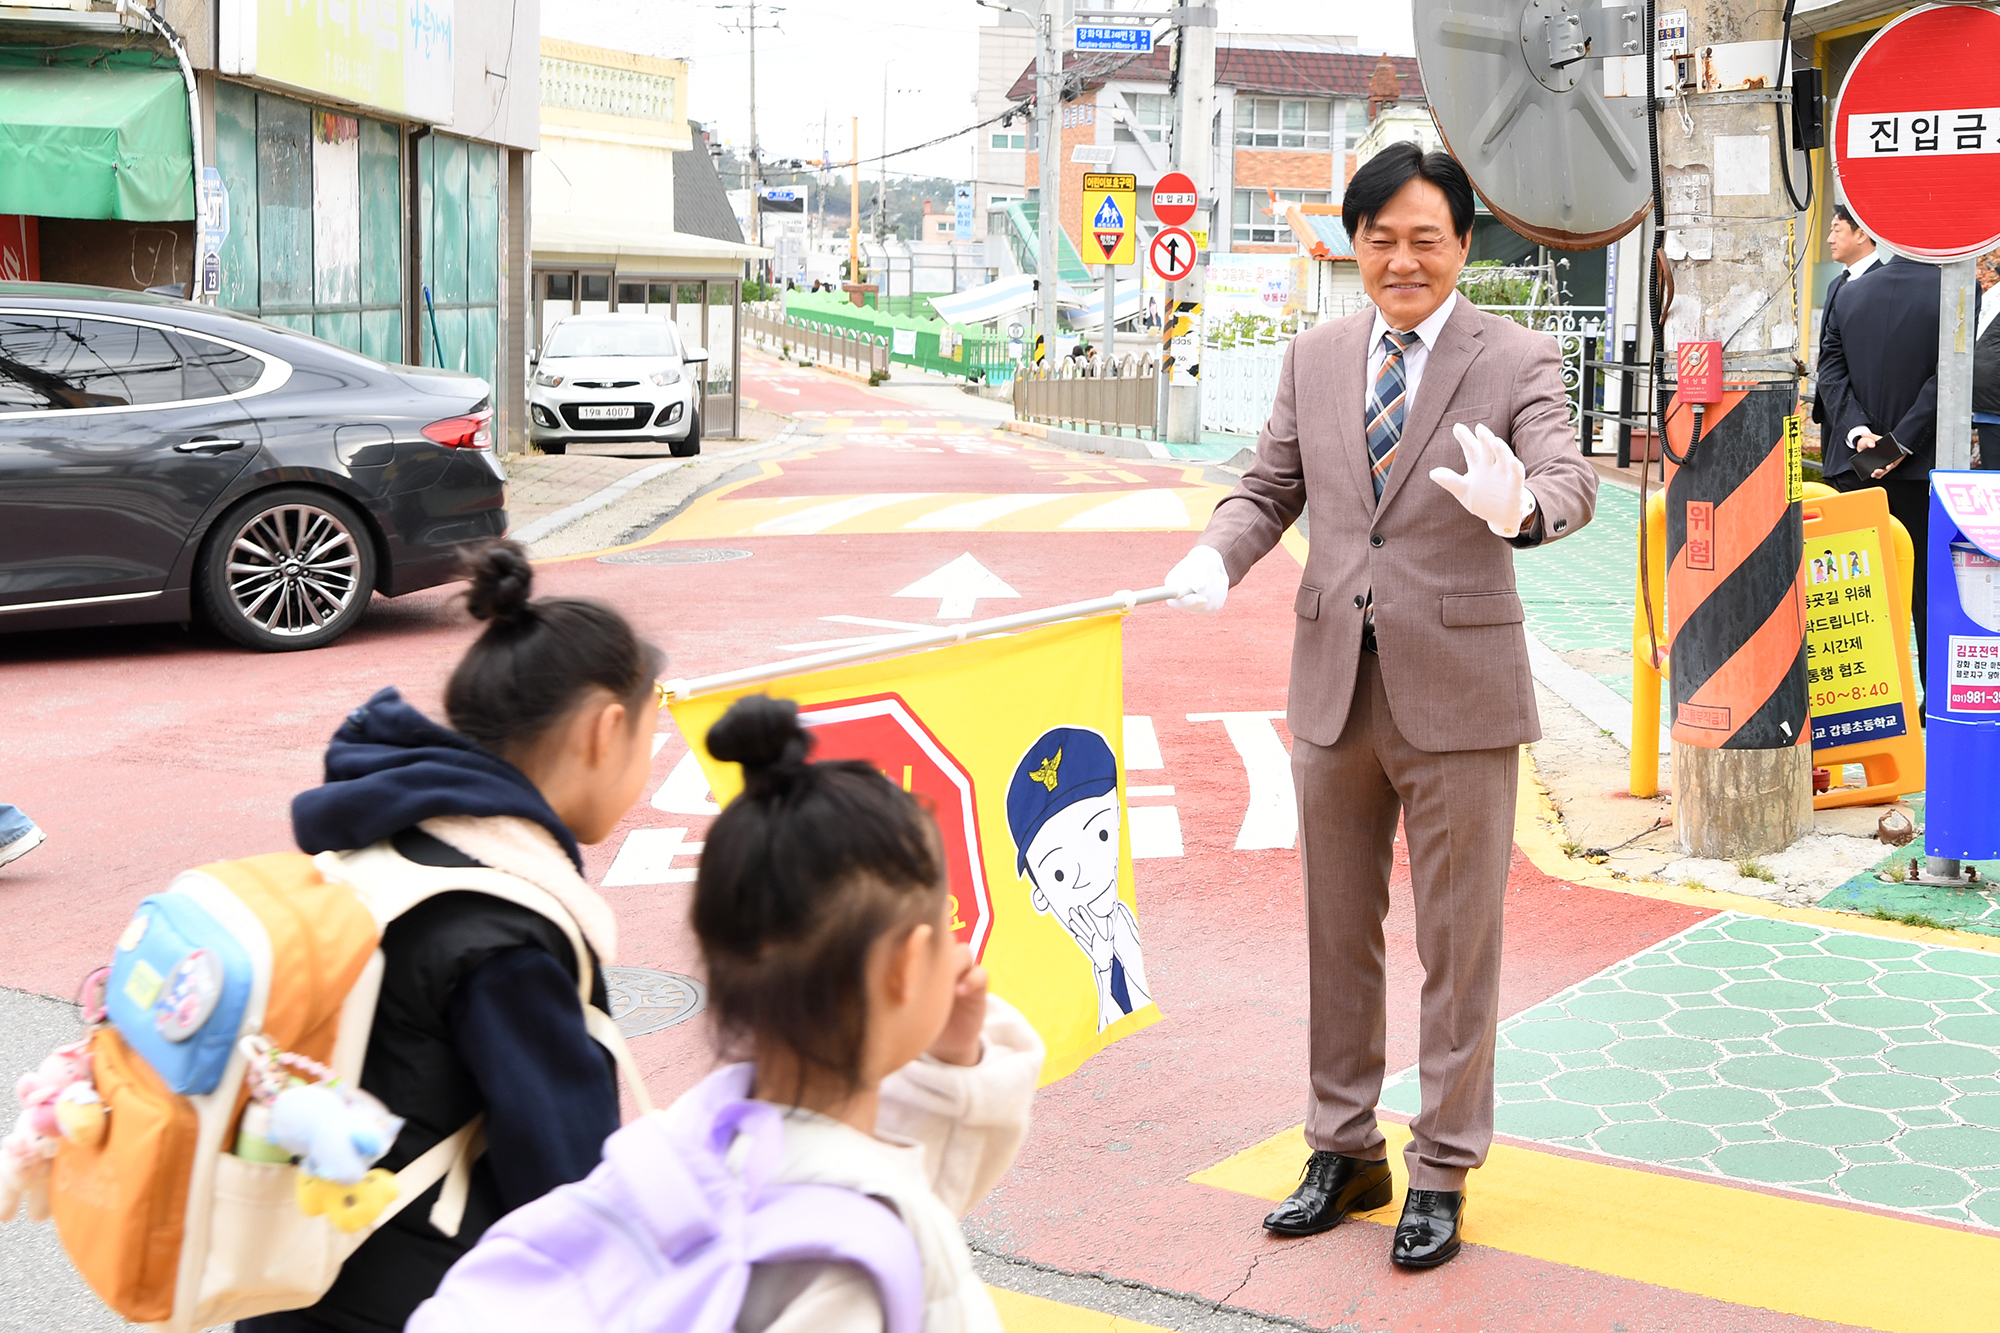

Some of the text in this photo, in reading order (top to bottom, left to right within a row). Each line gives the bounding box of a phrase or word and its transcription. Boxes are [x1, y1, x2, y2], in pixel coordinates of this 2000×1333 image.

[1869, 114, 2000, 153] 진입금
[1086, 176, 1132, 189] 어린이보호구역
[1156, 194, 1194, 204] 진입금지
[208, 271, 217, 289] 23
[1263, 293, 1287, 302] 부동산
[605, 407, 630, 417] 4007
[1689, 506, 1710, 564] 위험
[1845, 584, 1872, 602] 위해
[1822, 636, 1863, 655] 시간제
[1957, 645, 1998, 658] 김포전역
[1808, 661, 1867, 683] 통행 협조
[1829, 715, 1897, 737] 갑룡초등학교
